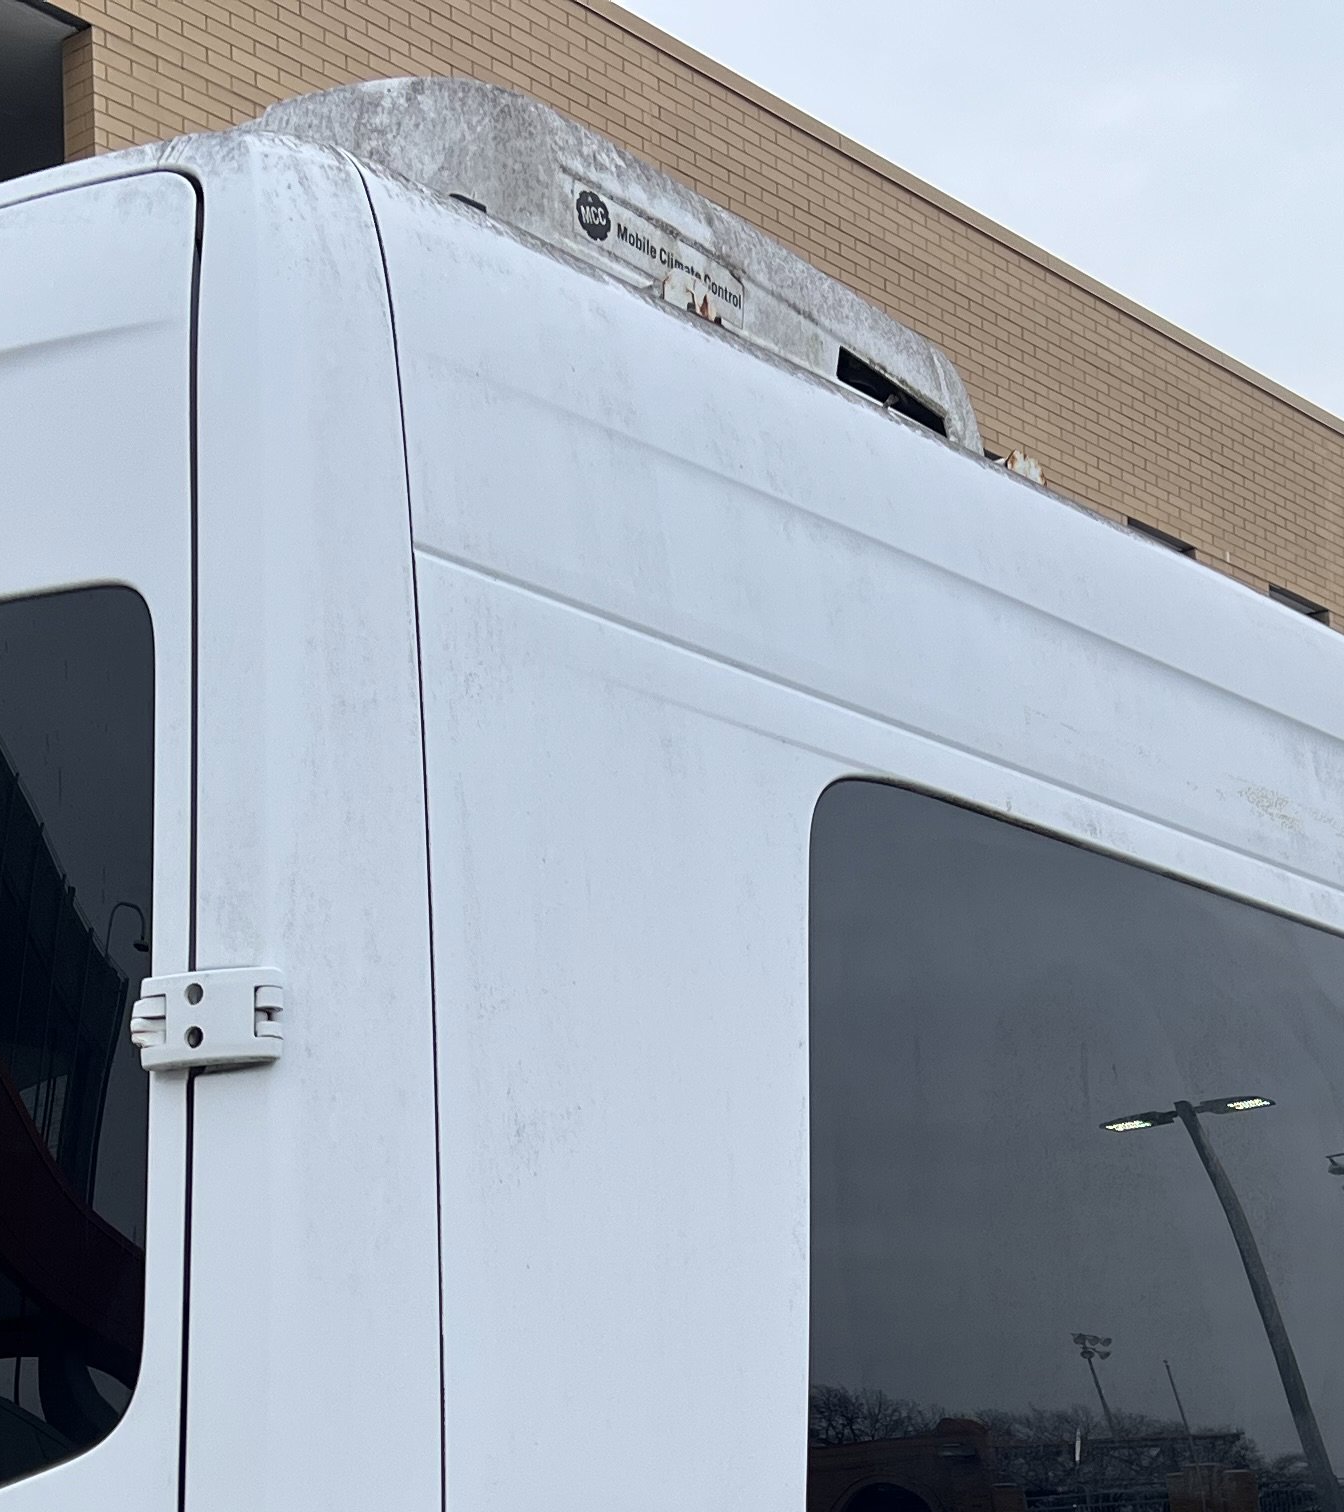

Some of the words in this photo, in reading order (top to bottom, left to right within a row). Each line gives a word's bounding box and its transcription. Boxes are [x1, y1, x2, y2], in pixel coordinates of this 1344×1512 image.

[580, 204, 607, 226] MCC
[617, 223, 657, 260] Mobile
[704, 273, 742, 310] Control
